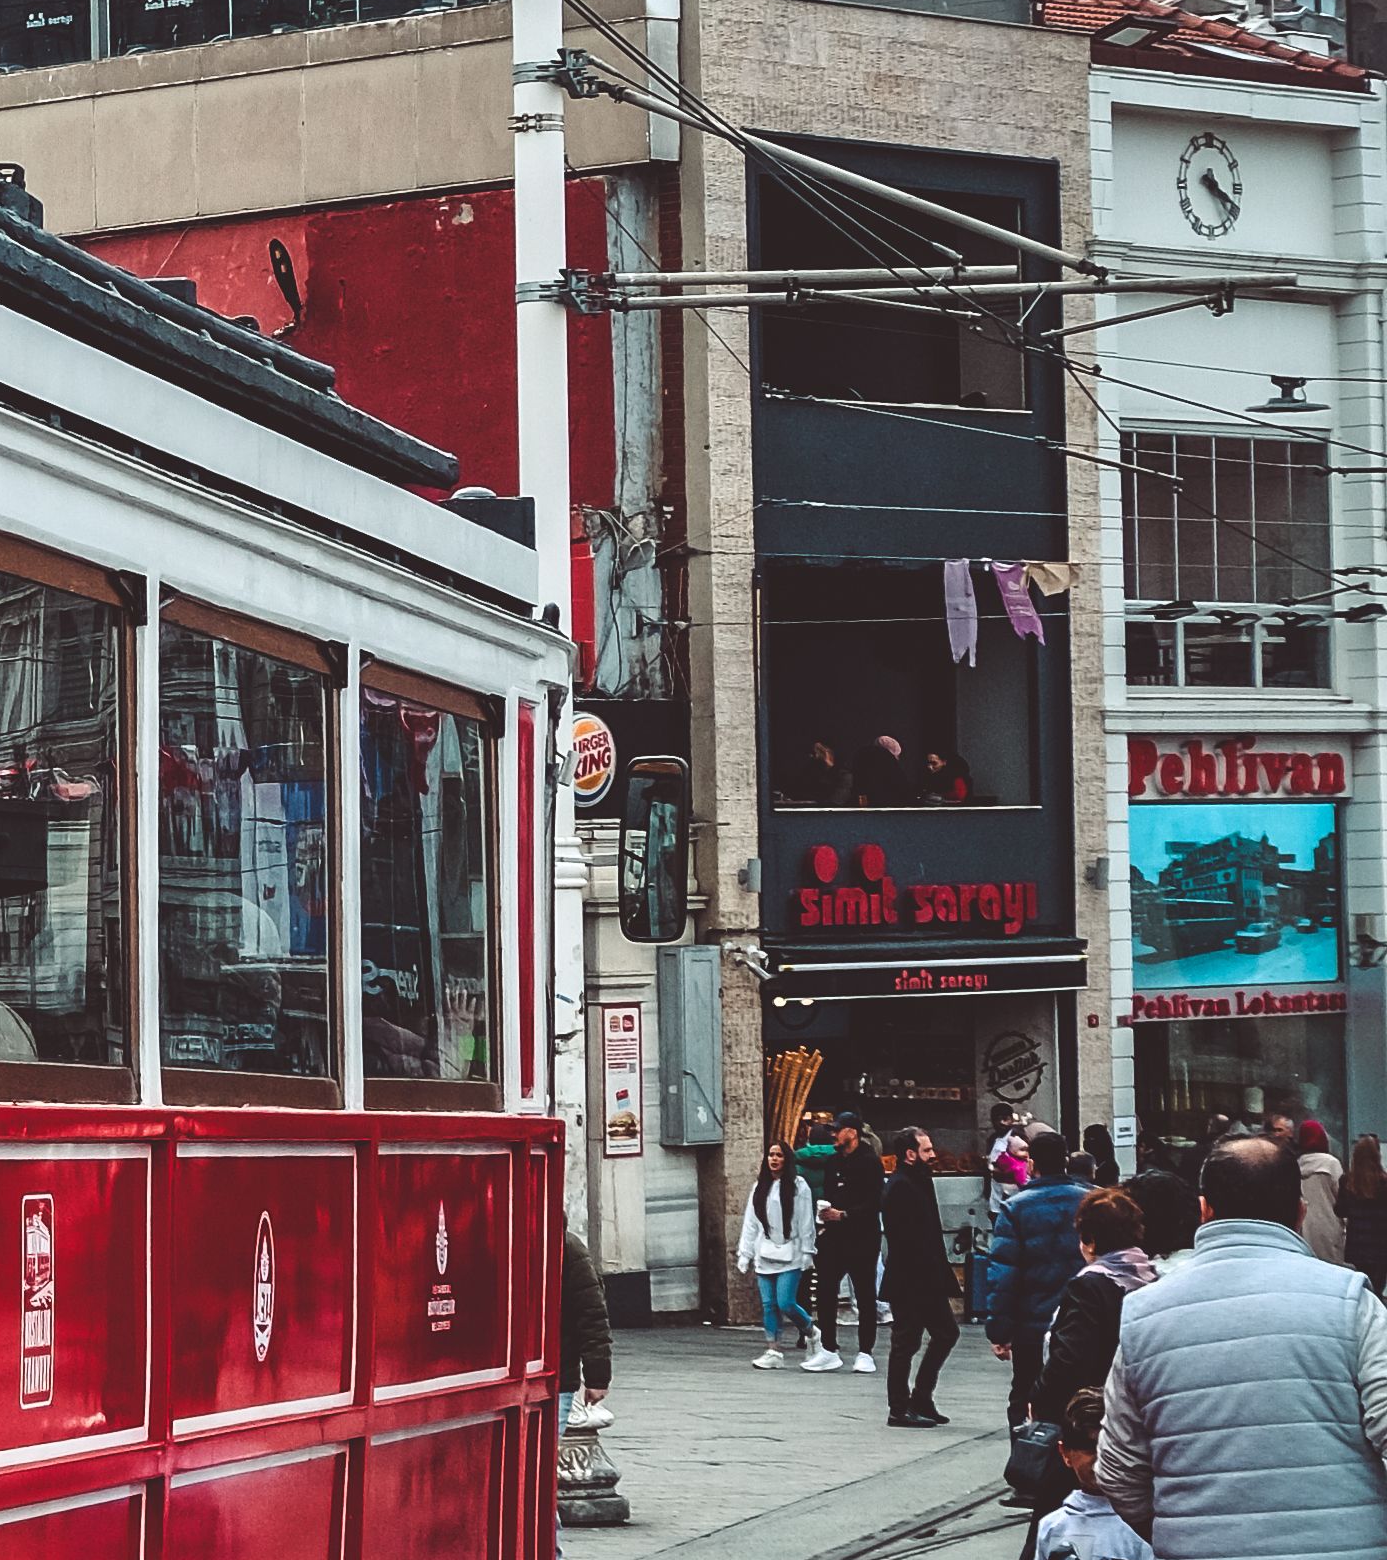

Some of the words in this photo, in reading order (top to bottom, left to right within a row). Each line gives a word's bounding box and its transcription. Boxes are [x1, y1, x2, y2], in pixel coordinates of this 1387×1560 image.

[573, 730, 610, 754] URGER
[1127, 734, 1347, 797] Pehlivan
[800, 843, 899, 926] simit
[1131, 993, 1232, 1019] Pehlivan
